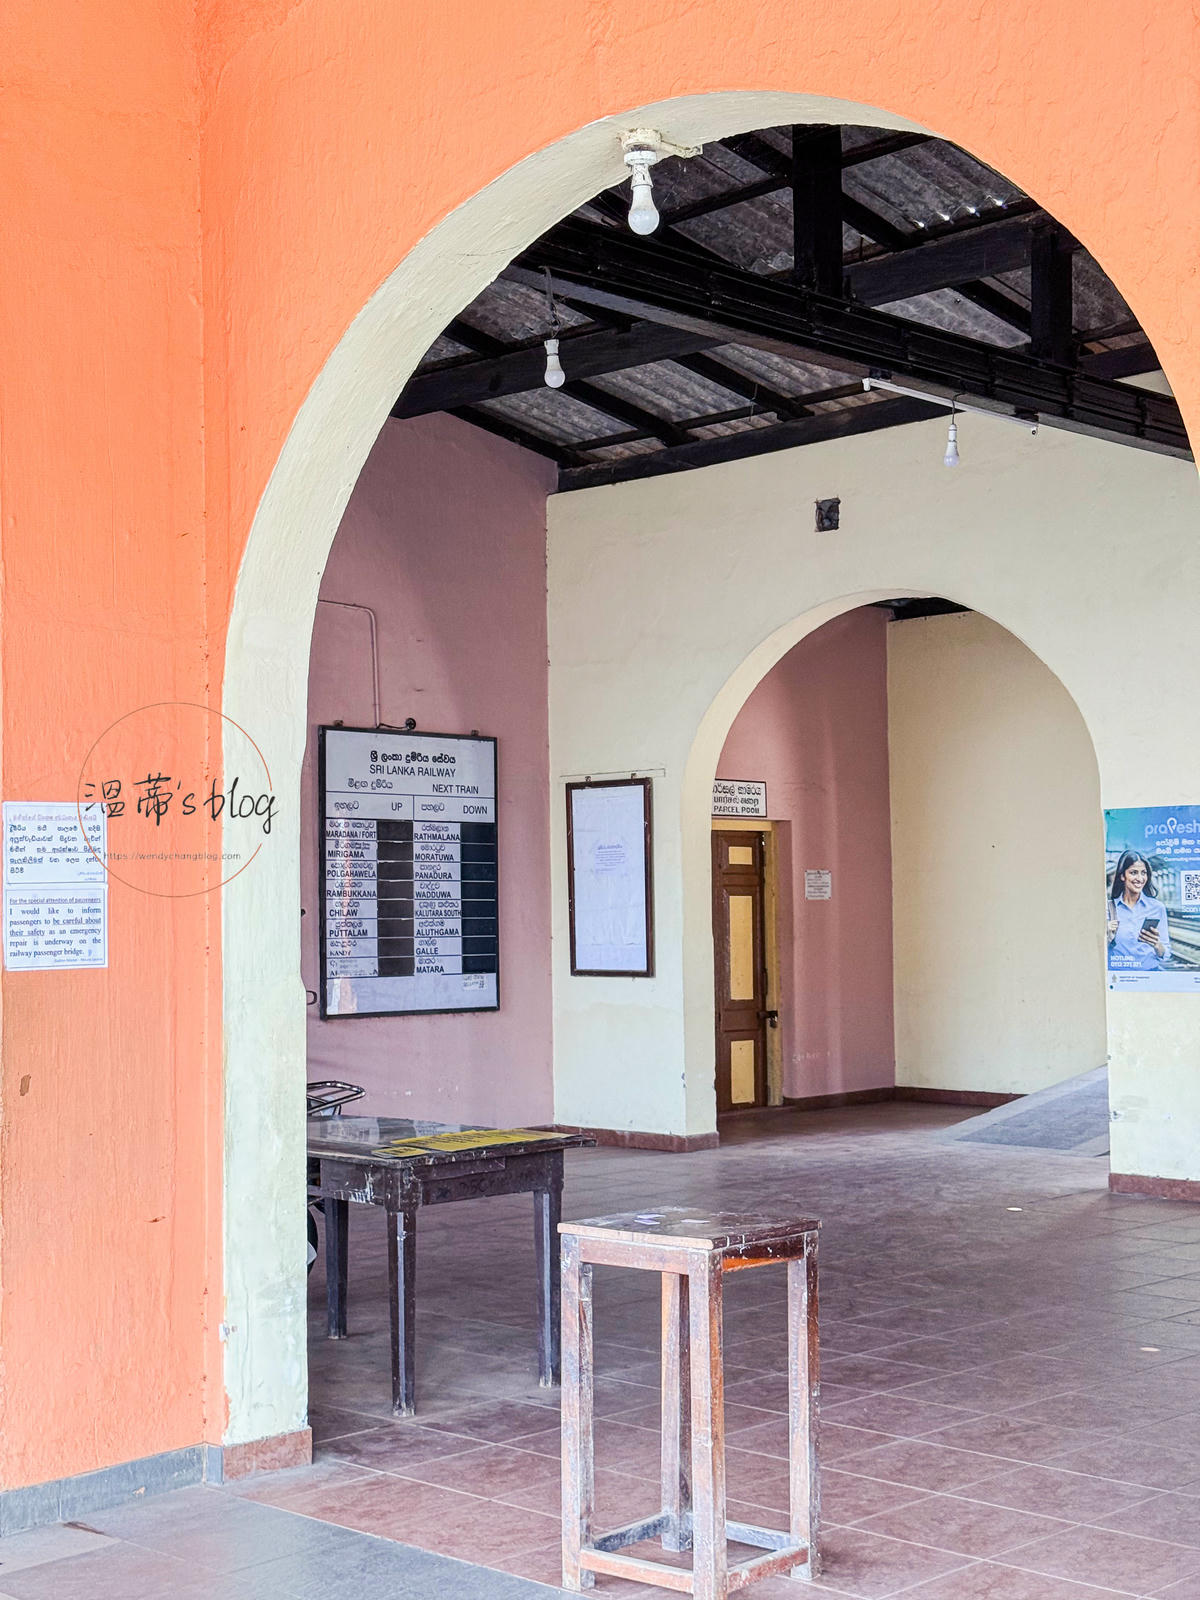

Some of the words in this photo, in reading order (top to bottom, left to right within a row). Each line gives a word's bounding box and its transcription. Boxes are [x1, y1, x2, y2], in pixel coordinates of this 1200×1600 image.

[381, 753, 402, 763] ලංකා
[405, 752, 429, 763] දුම්රිය
[432, 752, 456, 764] සේවය
[369, 765, 385, 774] SRI
[386, 766, 415, 776] LANKA
[417, 767, 456, 778] RAILWAY
[432, 784, 453, 793] NEXT
[455, 785, 479, 794] TRAIN
[713, 783, 735, 796] ාර්සල්
[391, 802, 403, 811] UP
[463, 805, 488, 815] DOWN
[714, 805, 739, 813] PARCEL
[326, 830, 358, 839] MARADANA
[362, 831, 376, 839] FORT
[414, 833, 461, 841] RATHMALANA
[327, 850, 365, 858] MIRIGAMA
[415, 853, 454, 861] MORATUWA
[327, 870, 376, 878] POLGAHAWELA
[415, 872, 452, 880] PANADURA
[326, 889, 377, 898] RAMBUKKANA
[416, 890, 451, 898] WADDUWA
[82, 906, 101, 914] inform
[329, 909, 358, 917] CHILAW
[415, 909, 442, 917] KALUTARA
[444, 909, 462, 917] SOUTH
[9, 919, 41, 927] passengers
[62, 917, 82, 925] careful
[28, 929, 45, 937] safety
[70, 928, 101, 936] emergency
[329, 929, 368, 938] PUTTALAM
[416, 928, 459, 936] ALUTHGAMA
[9, 940, 27, 948] repair
[44, 938, 73, 946] underway
[9, 950, 32, 958] railway
[33, 949, 62, 957] passenger
[64, 948, 84, 956] bridge.
[416, 947, 439, 955] GALLE
[416, 965, 444, 973] MATARA
